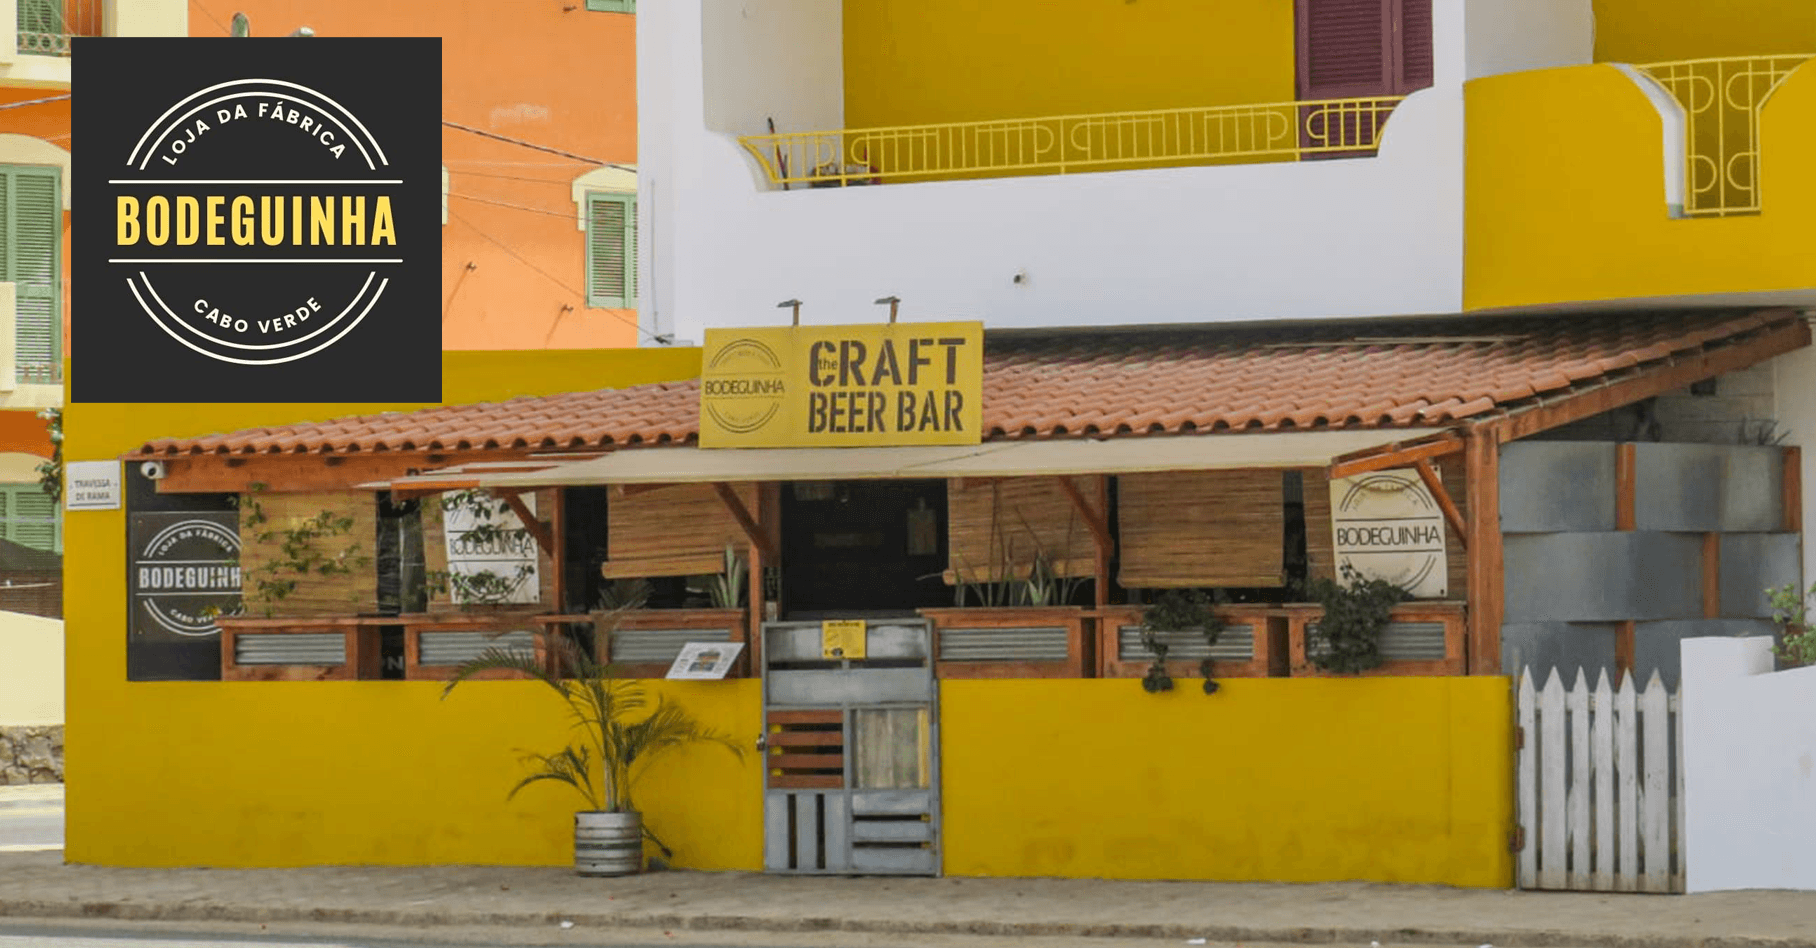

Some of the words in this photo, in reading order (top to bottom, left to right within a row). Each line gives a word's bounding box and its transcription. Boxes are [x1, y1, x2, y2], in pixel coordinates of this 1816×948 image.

[809, 337, 966, 387] CRAFT
[818, 358, 838, 370] the
[705, 380, 785, 395] BODEGUINHA
[808, 391, 886, 433] BEER
[897, 390, 963, 432] BAR
[1336, 525, 1442, 546] BODEGUINHA
[139, 567, 241, 588] BODEGUINH
